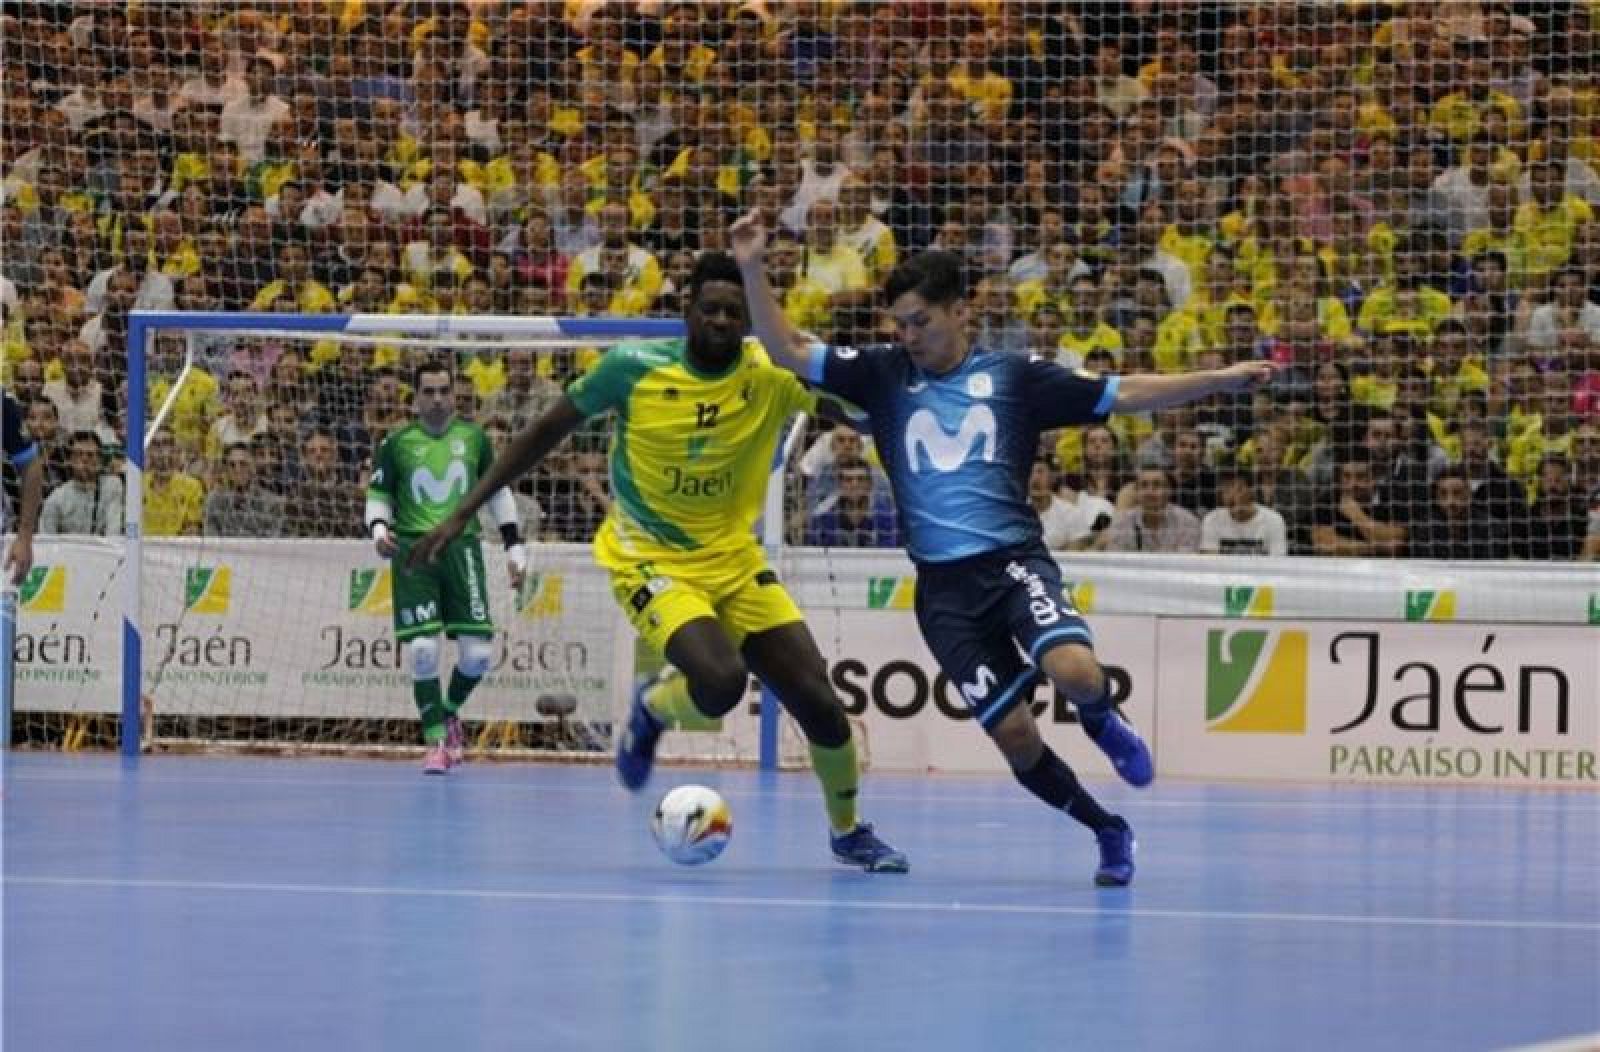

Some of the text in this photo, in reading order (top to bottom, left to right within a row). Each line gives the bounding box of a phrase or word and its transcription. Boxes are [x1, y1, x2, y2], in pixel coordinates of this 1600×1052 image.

[696, 402, 720, 429] 12
[156, 624, 252, 668] Jaén
[1329, 631, 1570, 736] Jaén
[1329, 738, 1599, 781] PARAÍSO INTER
